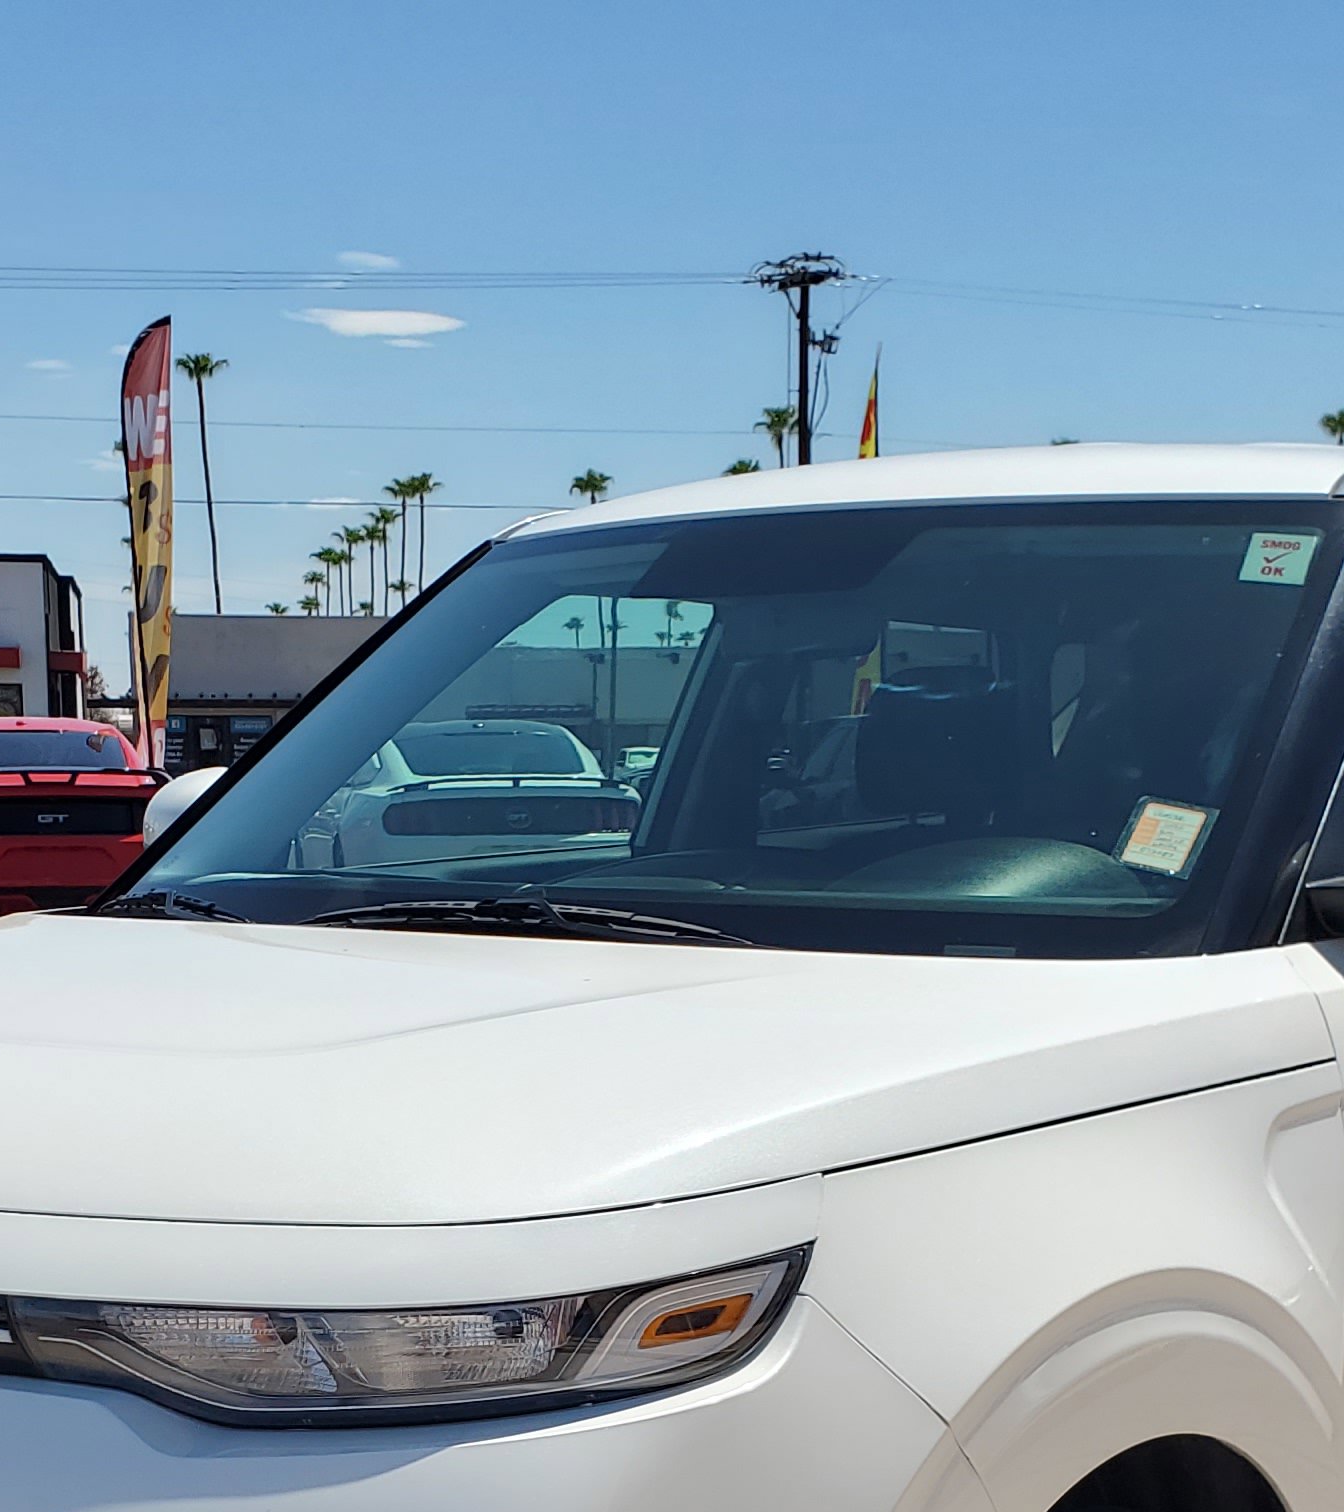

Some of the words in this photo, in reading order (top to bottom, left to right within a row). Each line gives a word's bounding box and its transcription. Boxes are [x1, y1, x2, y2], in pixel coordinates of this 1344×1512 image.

[123, 389, 169, 462] WE
[1260, 539, 1302, 551] SMOG
[1259, 565, 1286, 577] OK
[37, 814, 70, 823] GT
